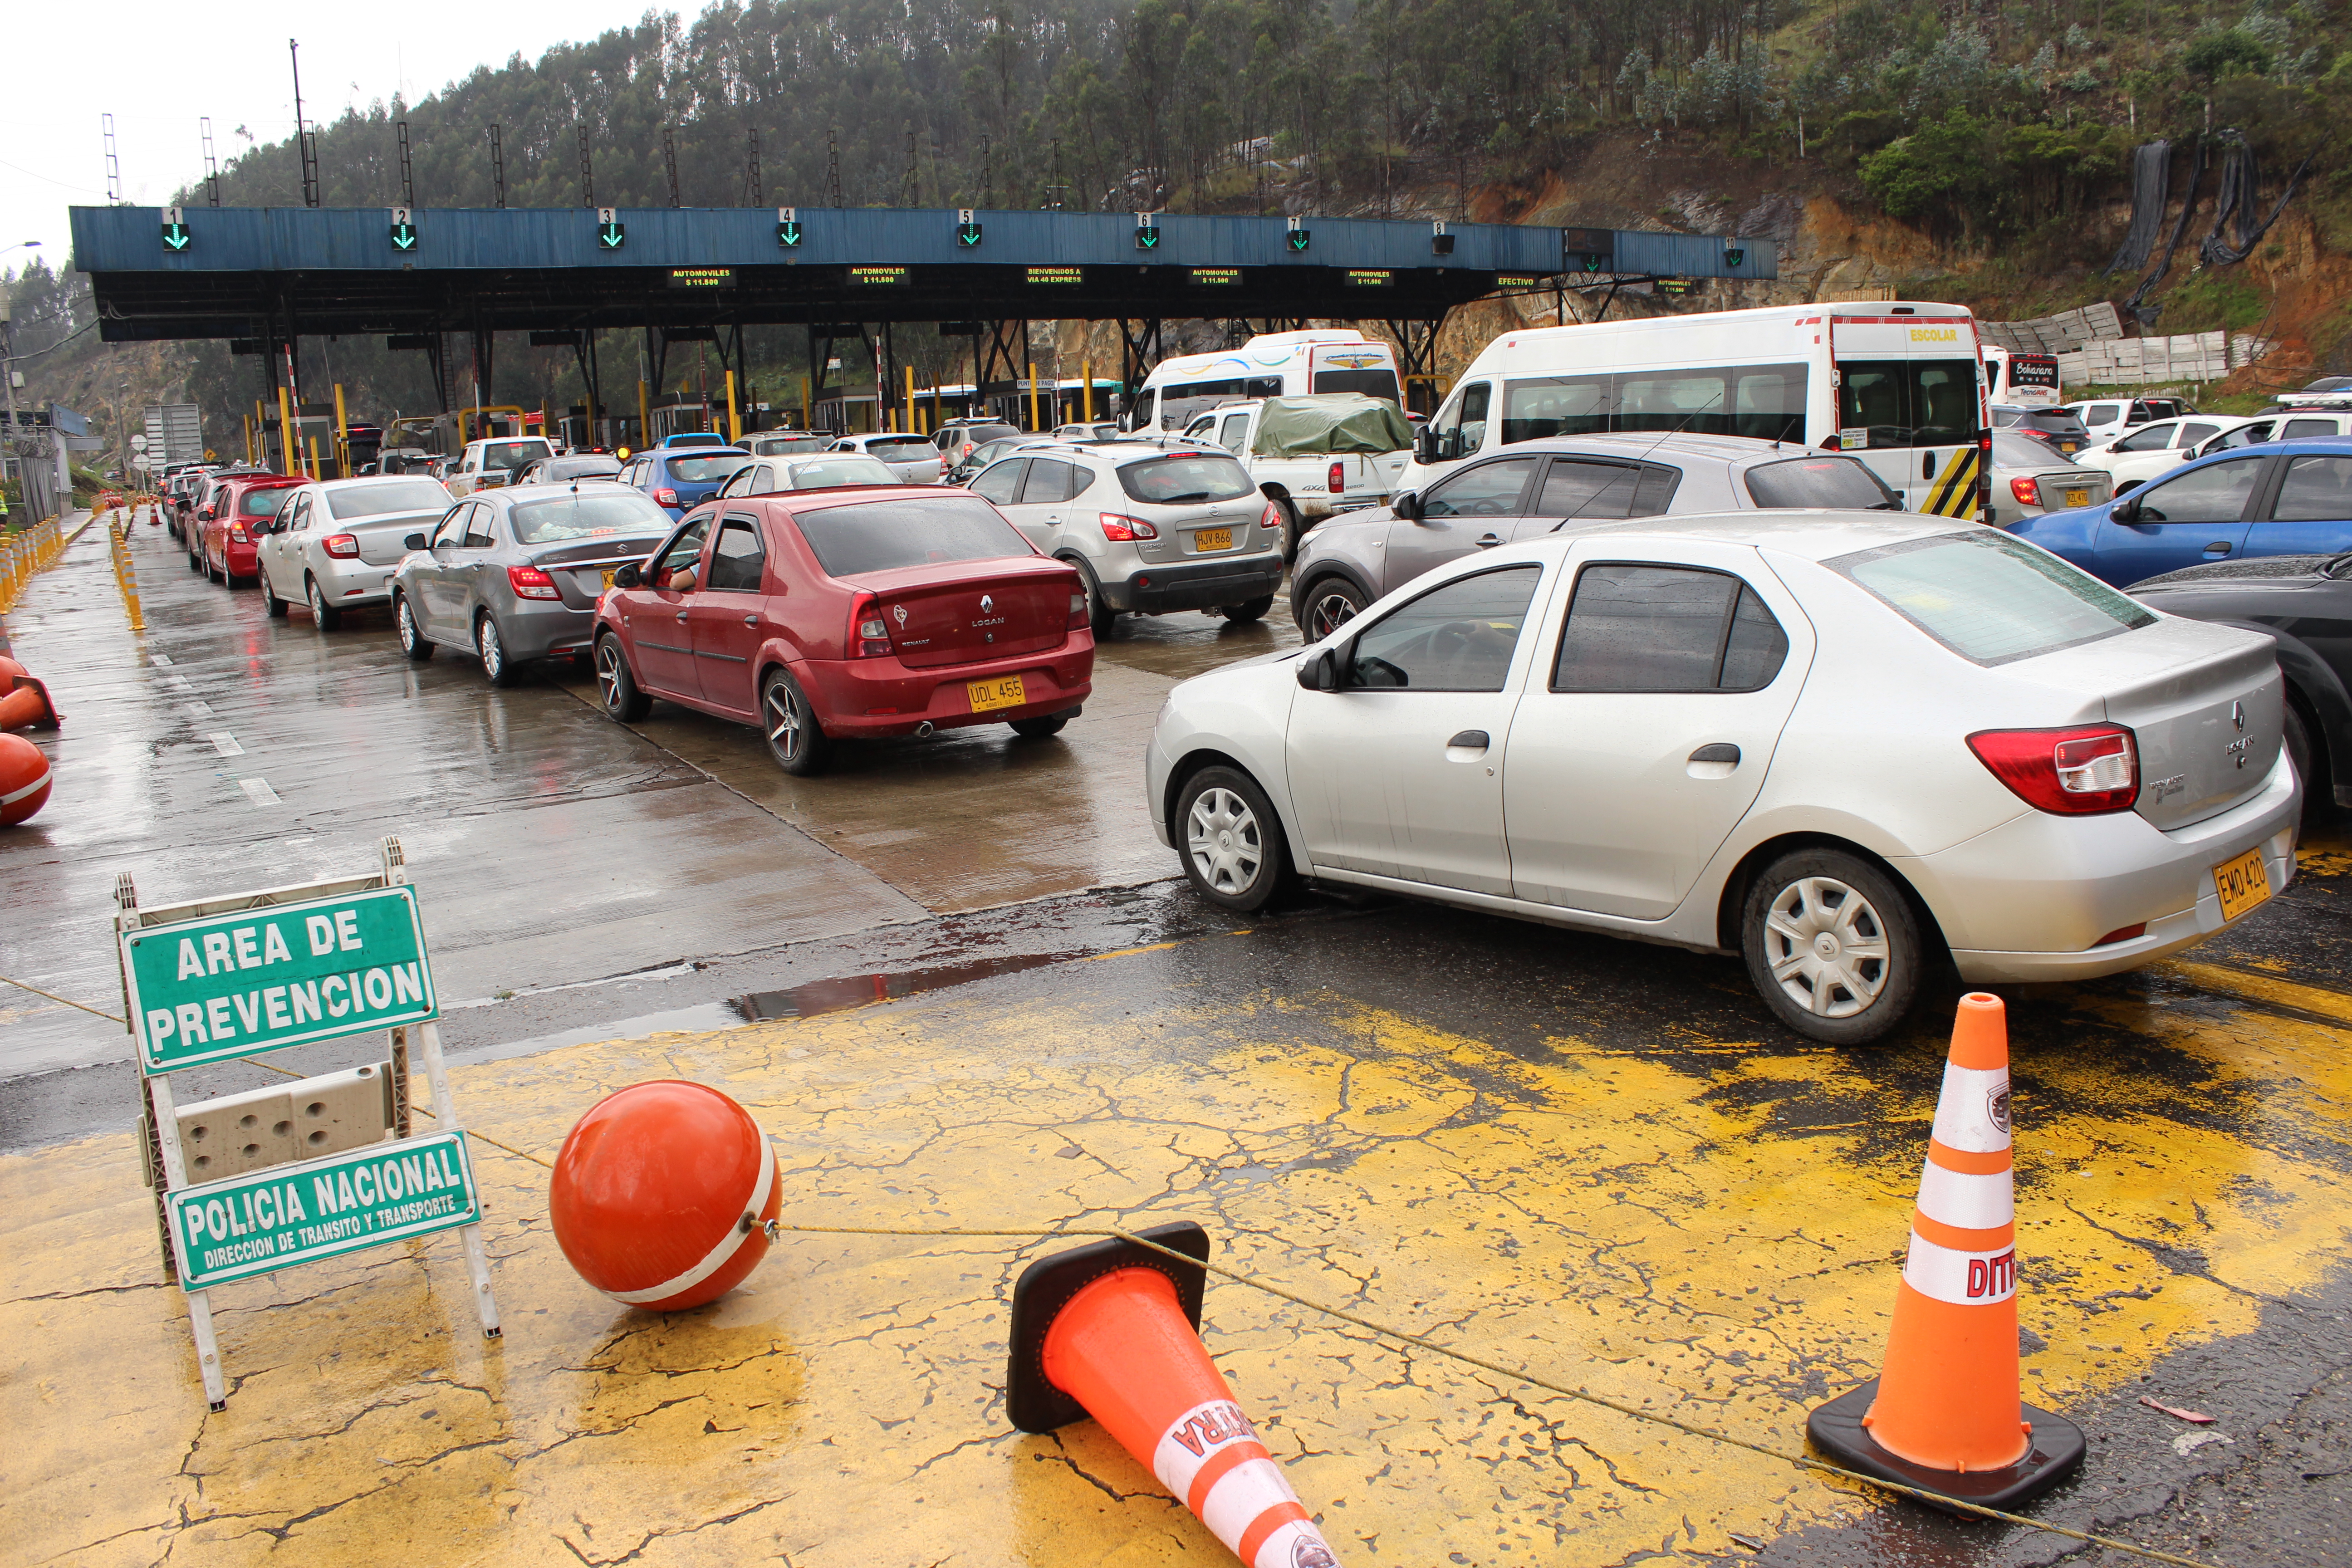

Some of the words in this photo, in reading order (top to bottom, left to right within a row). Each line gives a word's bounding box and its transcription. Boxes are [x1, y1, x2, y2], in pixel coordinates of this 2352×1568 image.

[170, 208, 176, 224] 1
[398, 210, 406, 225] 2
[604, 209, 611, 224] 3
[784, 209, 790, 223] 4
[964, 211, 969, 223] 5
[1142, 215, 1147, 227] 6
[1291, 218, 1296, 230] 7
[1436, 223, 1441, 234] 8
[1726, 238, 1734, 248] 10
[1498, 277, 1534, 285] EFECTIVO
[1910, 329, 1957, 341] ESCOLAR
[2016, 362, 2053, 375] Bolivariano
[1198, 534, 1213, 545] HJV
[1215, 531, 1230, 544] 866
[972, 617, 1004, 627] LOGAN
[970, 685, 996, 703] UDL
[999, 681, 1022, 698] 455
[2225, 735, 2254, 755] LOGAN
[2149, 774, 2185, 790] RENAULT
[2244, 856, 2265, 891] 420
[177, 923, 293, 981] AREA
[305, 909, 363, 956] DE
[147, 961, 423, 1052] PREVENCION
[185, 1182, 307, 1246] POLICIA
[314, 1148, 461, 1216] NACIONAL
[204, 1236, 275, 1270] DIRECCION
[278, 1231, 296, 1253] DE
[301, 1215, 362, 1246] TRANSITO
[363, 1212, 373, 1231] Y
[377, 1193, 457, 1228] TRANSPORTE
